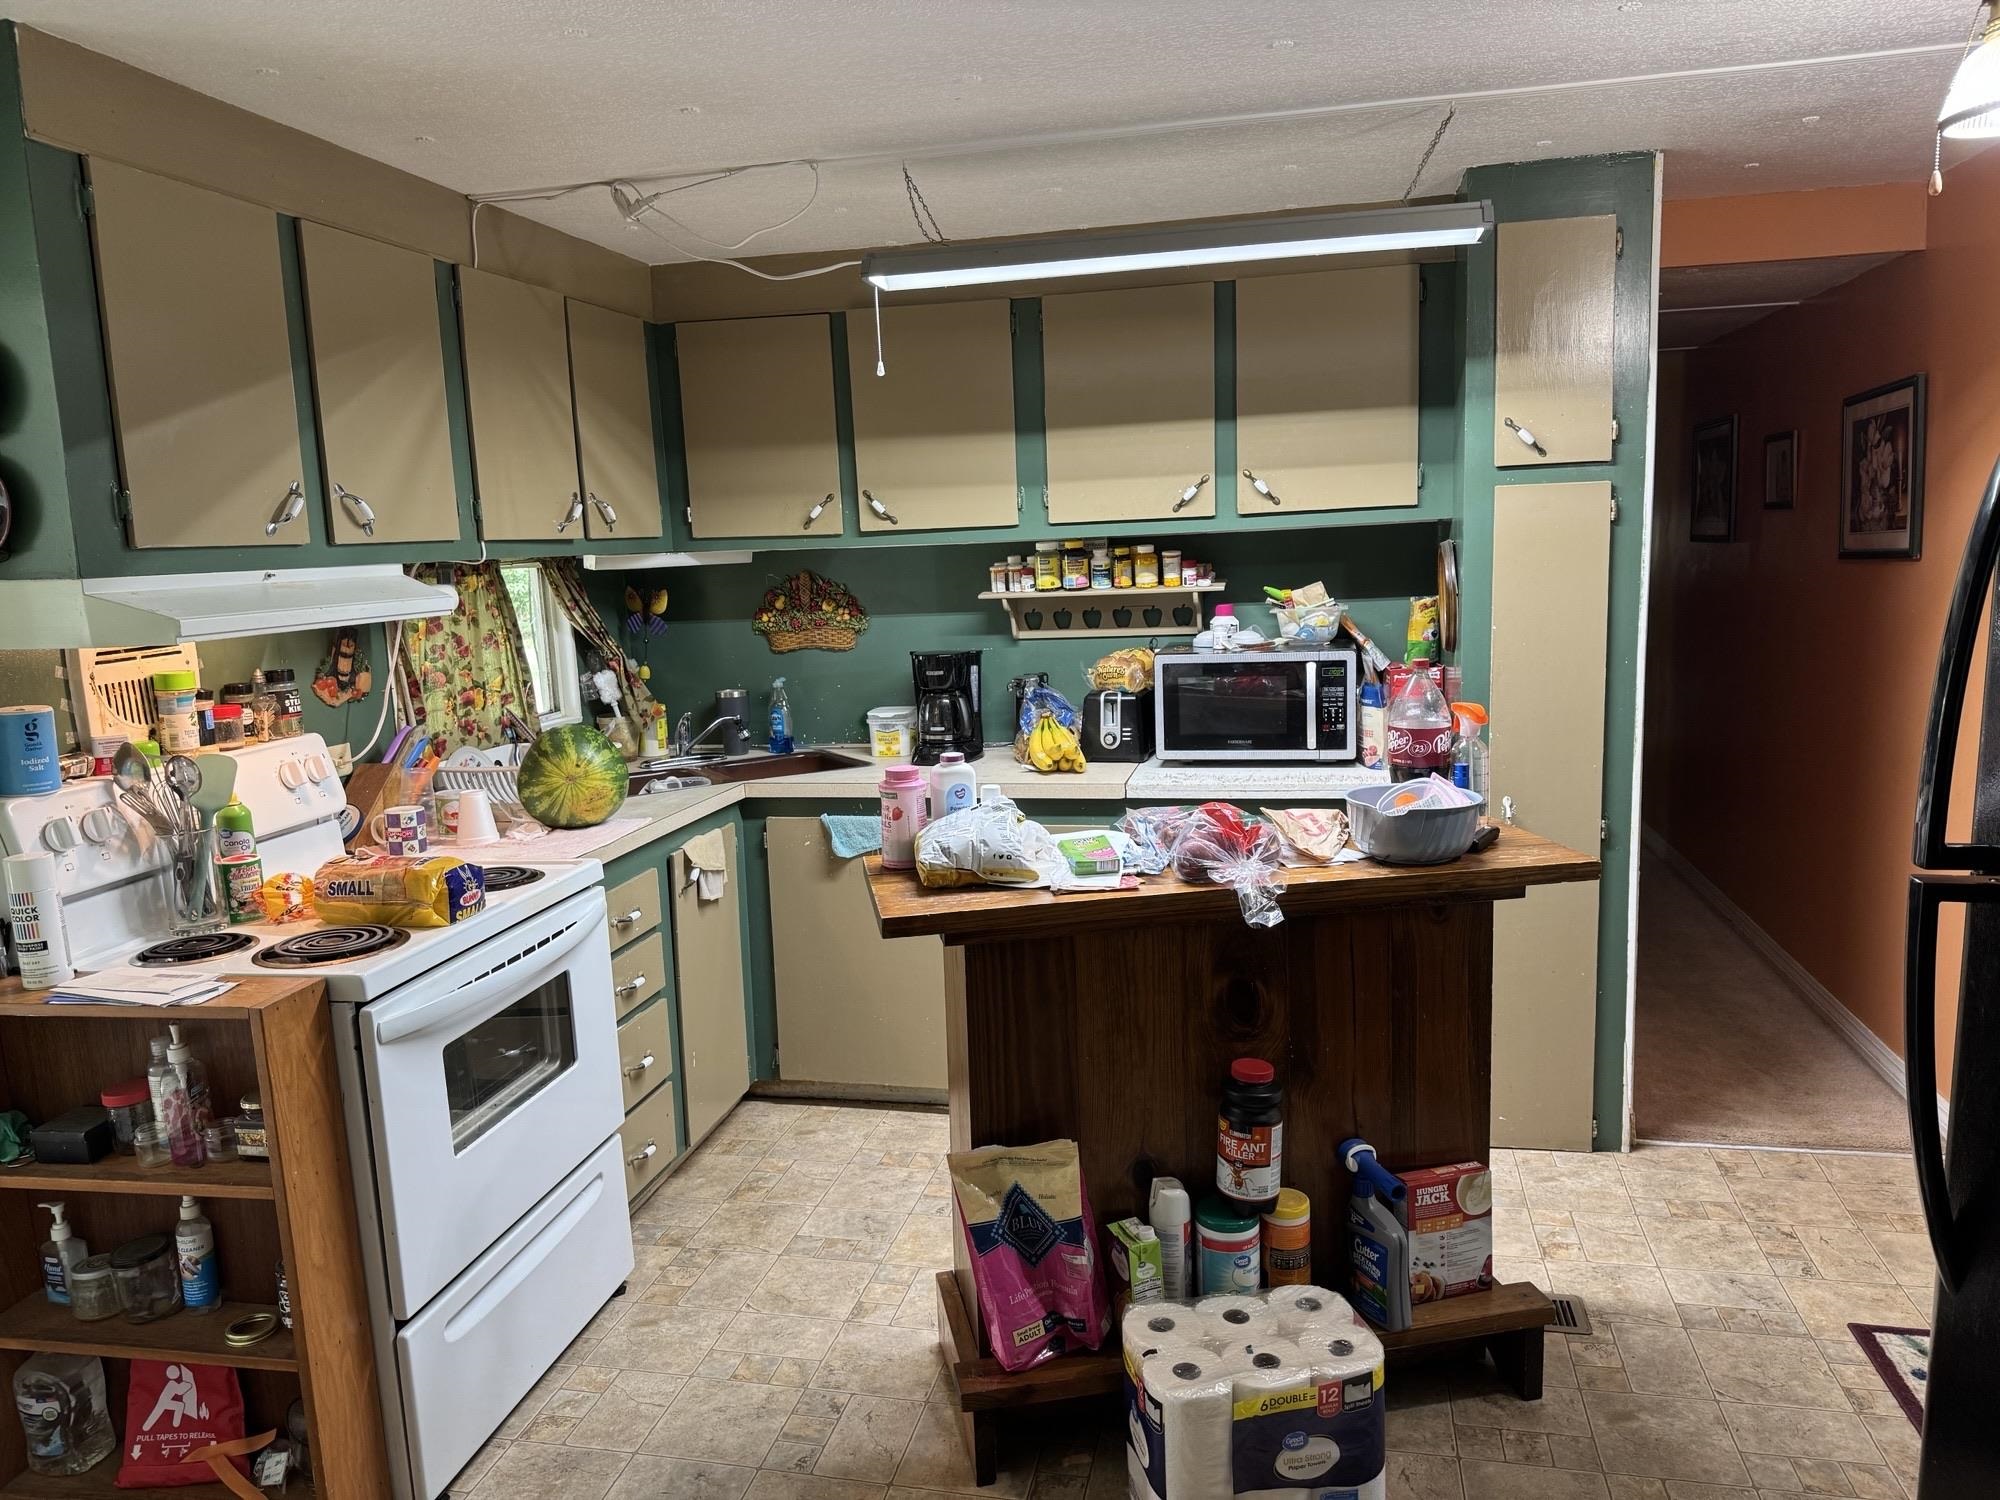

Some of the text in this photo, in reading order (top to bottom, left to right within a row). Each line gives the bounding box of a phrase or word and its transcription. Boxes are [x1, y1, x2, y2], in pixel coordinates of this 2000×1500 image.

[1414, 745, 1424, 753] 23
[21, 756, 50, 766] Iodized
[29, 764, 44, 772] Salt
[223, 838, 250, 848] Canola
[240, 843, 250, 851] Oil
[327, 880, 375, 897] SMALL
[11, 906, 39, 915] QUICK
[455, 902, 486, 923] SMALL
[13, 914, 40, 923] COLOR
[1220, 1132, 1267, 1153] FIRE ANT
[1225, 1146, 1256, 1160] KILLER
[1416, 1184, 1449, 1197] HUNGRY
[1415, 1191, 1451, 1207] JACK
[1354, 1238, 1380, 1262] Cutter
[1018, 1328, 1042, 1344] ADULT
[1260, 1401, 1268, 1412] 6
[1269, 1392, 1309, 1408] DOUBLE
[1320, 1387, 1339, 1404] 12
[136, 1433, 155, 1442] PULL
[156, 1432, 178, 1441] TAPES
[179, 1432, 188, 1440] TO
[1285, 1436, 1304, 1446] Great
[1283, 1450, 1332, 1466] Ultra Strong
[1288, 1459, 1327, 1472] Paper Towels
